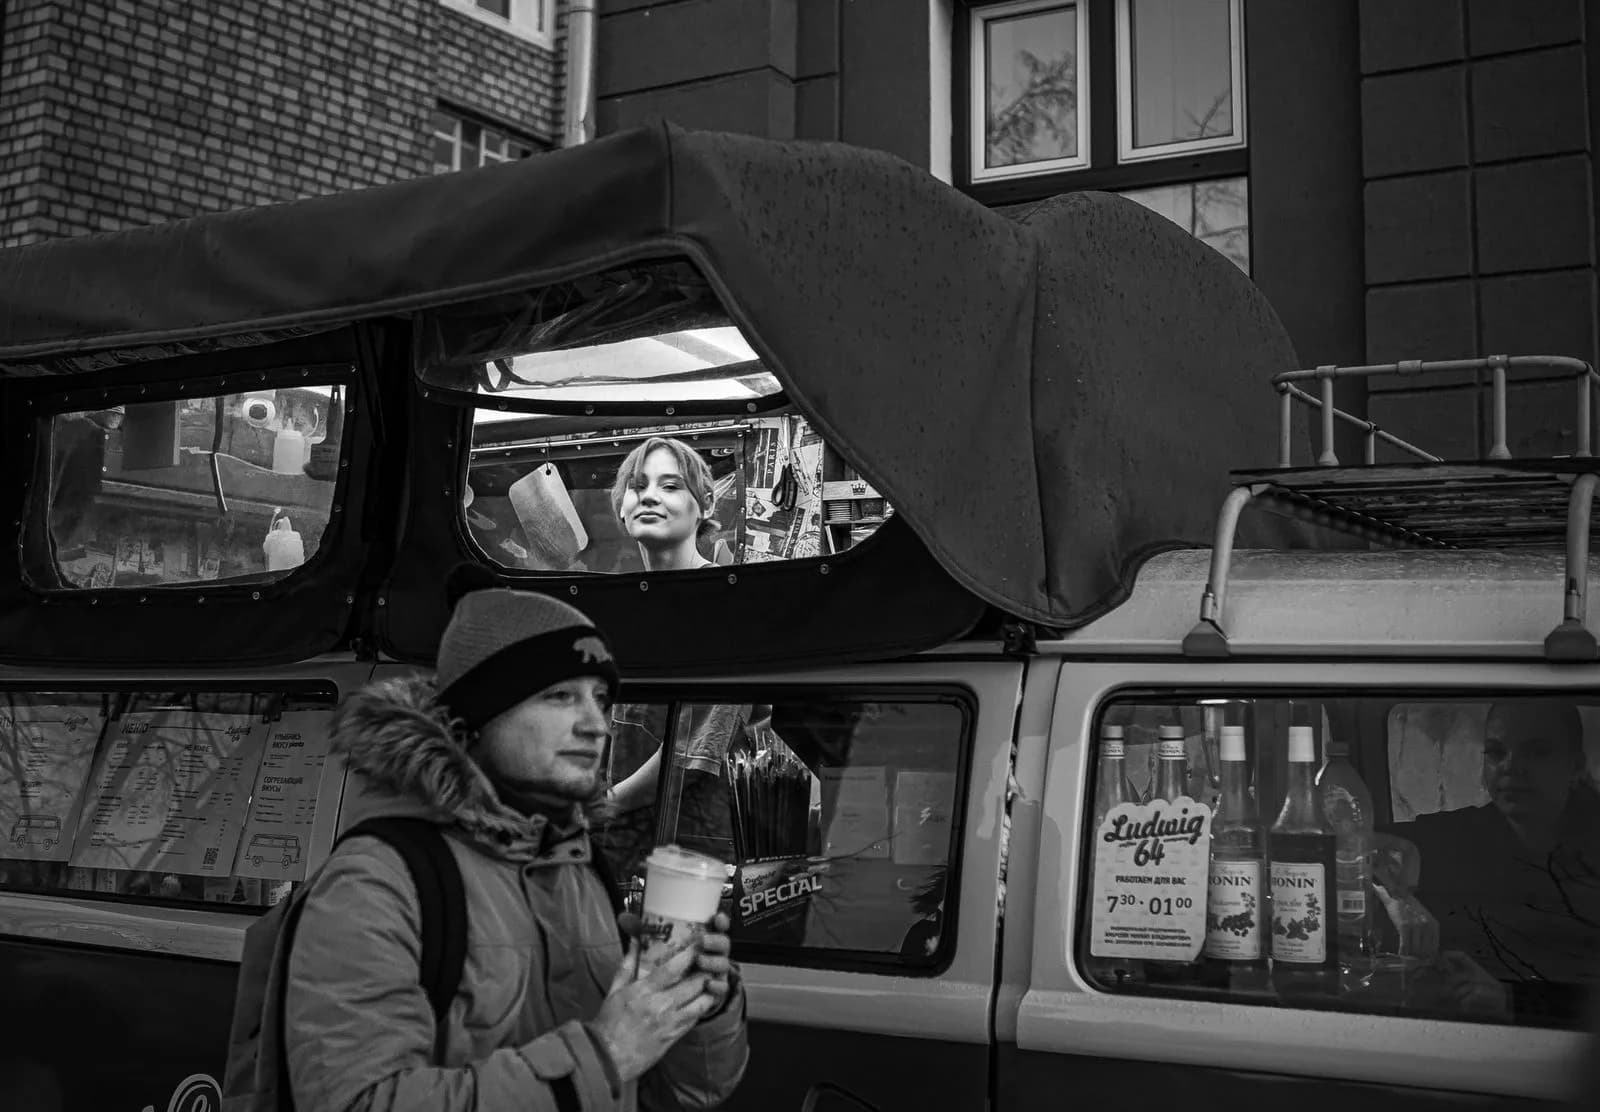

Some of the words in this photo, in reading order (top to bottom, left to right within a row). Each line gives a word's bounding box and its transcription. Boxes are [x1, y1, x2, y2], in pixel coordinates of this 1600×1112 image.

[767, 441, 777, 474] PARIS
[1103, 807, 1206, 845] Ludwig
[1133, 838, 1166, 867] 64
[738, 875, 823, 917] SPECIAL
[1115, 875, 1153, 885] РАБОТАЕМ
[1154, 876, 1170, 885] ДЛЯ
[1171, 876, 1187, 886] ВАС
